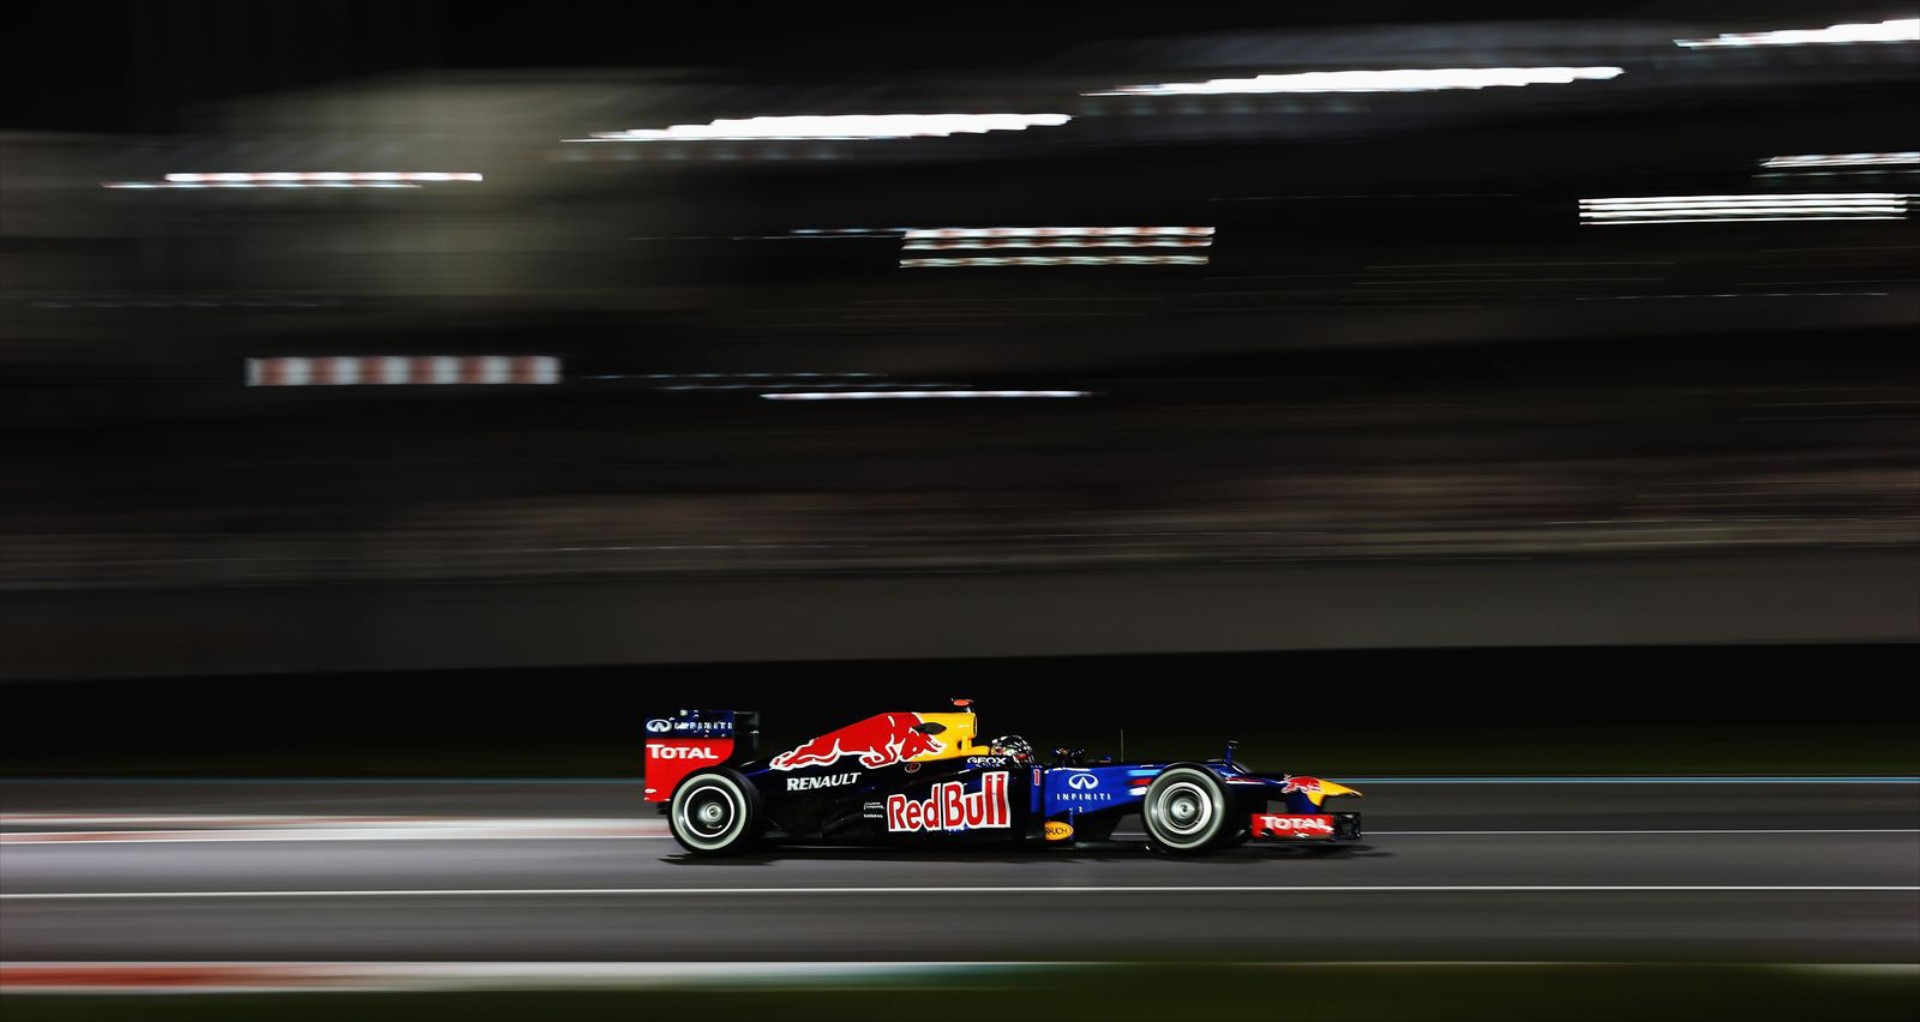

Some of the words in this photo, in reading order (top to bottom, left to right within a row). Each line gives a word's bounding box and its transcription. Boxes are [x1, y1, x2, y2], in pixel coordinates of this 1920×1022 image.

[646, 744, 719, 759] TOTAL
[786, 772, 862, 791] RENAULT
[1056, 792, 1112, 801] INFINITI
[1260, 815, 1335, 832] TOTAL
